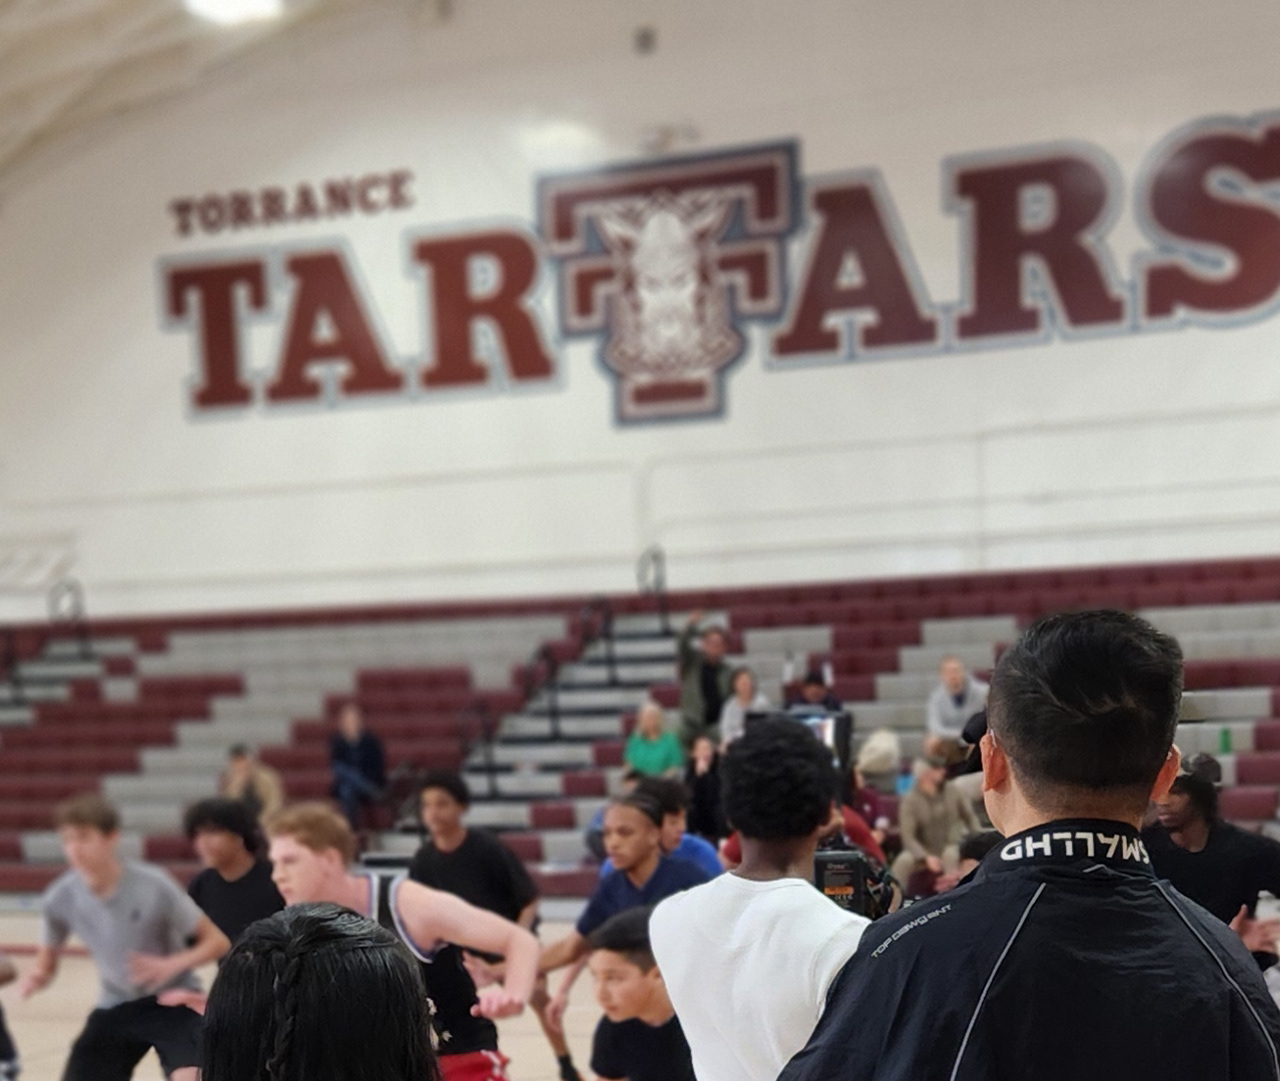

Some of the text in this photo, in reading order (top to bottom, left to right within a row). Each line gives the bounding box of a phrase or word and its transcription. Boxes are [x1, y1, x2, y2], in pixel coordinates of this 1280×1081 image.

[169, 167, 417, 237] TORRANCE
[1000, 831, 1151, 865] SMALLHD
[871, 937, 893, 958] TOP
